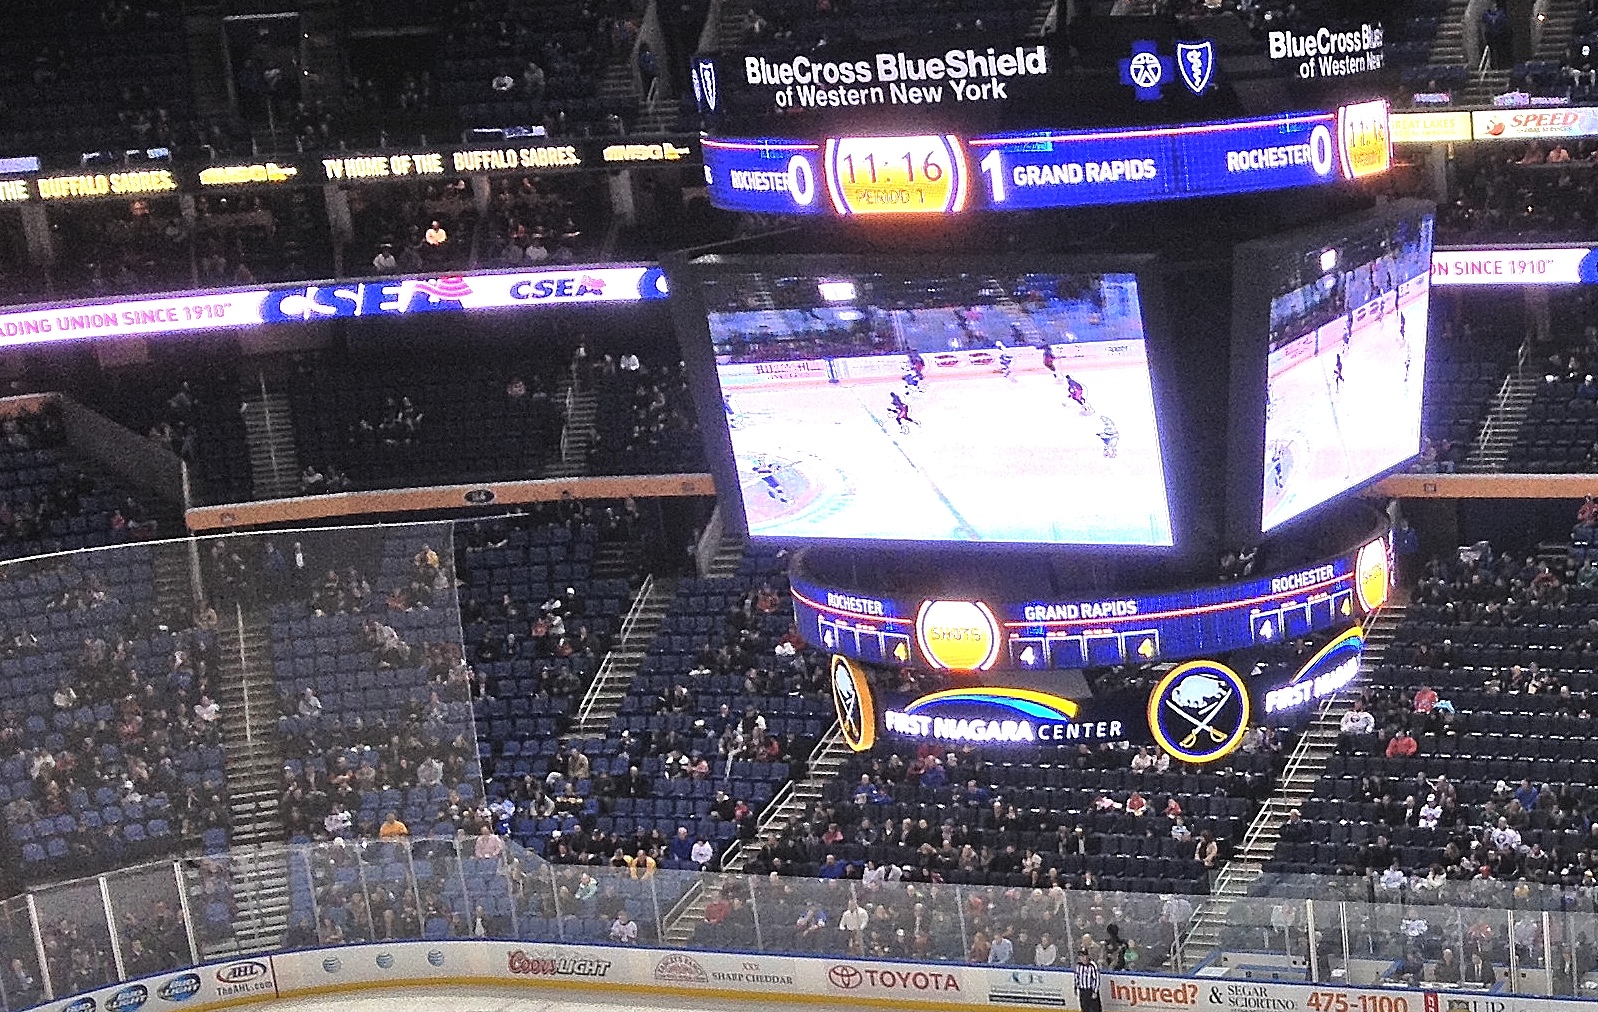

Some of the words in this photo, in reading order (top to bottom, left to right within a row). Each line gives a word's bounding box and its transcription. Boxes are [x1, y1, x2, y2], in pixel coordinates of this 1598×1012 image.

[1268, 27, 1361, 60] BlueCross
[745, 55, 872, 86] BlueCross
[875, 45, 1048, 83] BlueShield
[1299, 61, 1316, 79] of
[1318, 54, 1366, 77] Western
[776, 87, 793, 108] of
[797, 84, 884, 108] Western
[890, 83, 942, 105] New
[950, 77, 1008, 101] York
[1423, 118, 1455, 129] LAKES
[1509, 111, 1579, 128] SPEED
[1227, 143, 1311, 173] ROCHESTER
[1310, 124, 1332, 175] 0
[322, 159, 343, 179] TV
[344, 156, 390, 177] HOME
[389, 154, 411, 175] OF
[413, 152, 444, 174] THE
[453, 148, 519, 172] BUFFALO
[520, 146, 582, 168] SABRES.
[842, 150, 943, 186] 11:16
[36, 174, 110, 199] BUFFALO
[730, 170, 790, 193] ROCHESTER
[786, 154, 814, 206] 0
[980, 149, 1006, 202] 1
[1013, 163, 1083, 187] GRAND
[1085, 158, 1156, 183] RAPIDS
[854, 188, 911, 205] PERIOD
[915, 187, 927, 204] 1
[1454, 260, 1504, 276] SINCE
[509, 276, 606, 300] CSEA
[56, 312, 119, 332] UNION
[123, 308, 179, 326] SINCE
[1271, 564, 1335, 593] ROCHESTER
[827, 592, 883, 616] ROCHESTER
[1024, 604, 1080, 621] GRAND
[1081, 600, 1138, 618] RAPIDS
[1019, 645, 1036, 666] 4
[1265, 680, 1313, 713] FIRST
[884, 710, 932, 738] FIRST
[933, 715, 1034, 742] NIAGARA
[1037, 721, 1122, 741] CENTER
[229, 962, 256, 979] AHL
[557, 958, 612, 976] LIGHT
[712, 971, 744, 982] SHARP
[745, 974, 793, 986] CHEDDAR
[216, 981, 274, 996] TheAHL.com
[864, 968, 961, 992] TOYOTA
[1110, 979, 1198, 1007] Injured?
[1208, 985, 1223, 1004] &
[1227, 984, 1268, 998] SEGAR
[1228, 996, 1295, 1011] SCIORTINO
